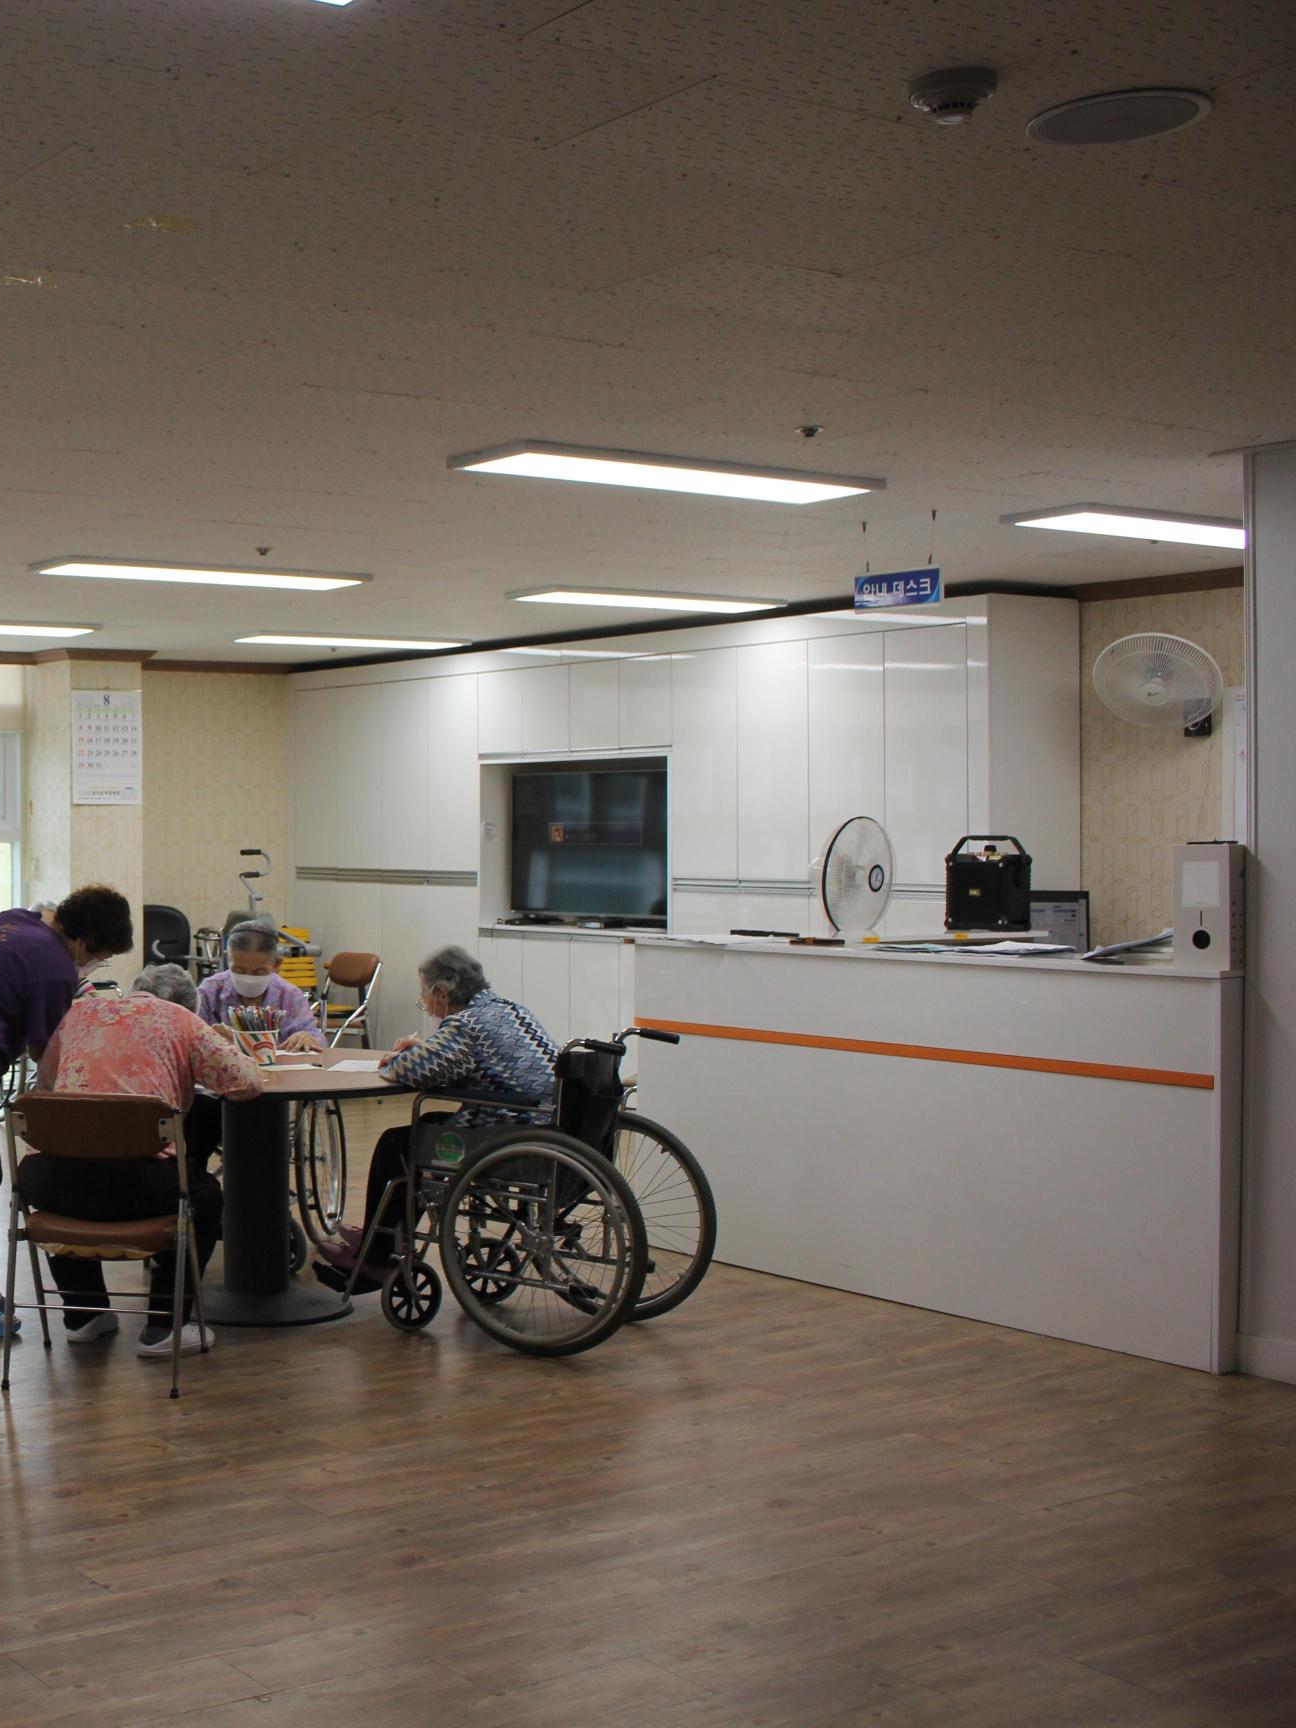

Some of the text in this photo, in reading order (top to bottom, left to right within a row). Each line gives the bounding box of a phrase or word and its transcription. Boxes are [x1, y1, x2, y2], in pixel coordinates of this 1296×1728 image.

[862, 578, 931, 601] 안내 데스크
[103, 694, 111, 706] 8
